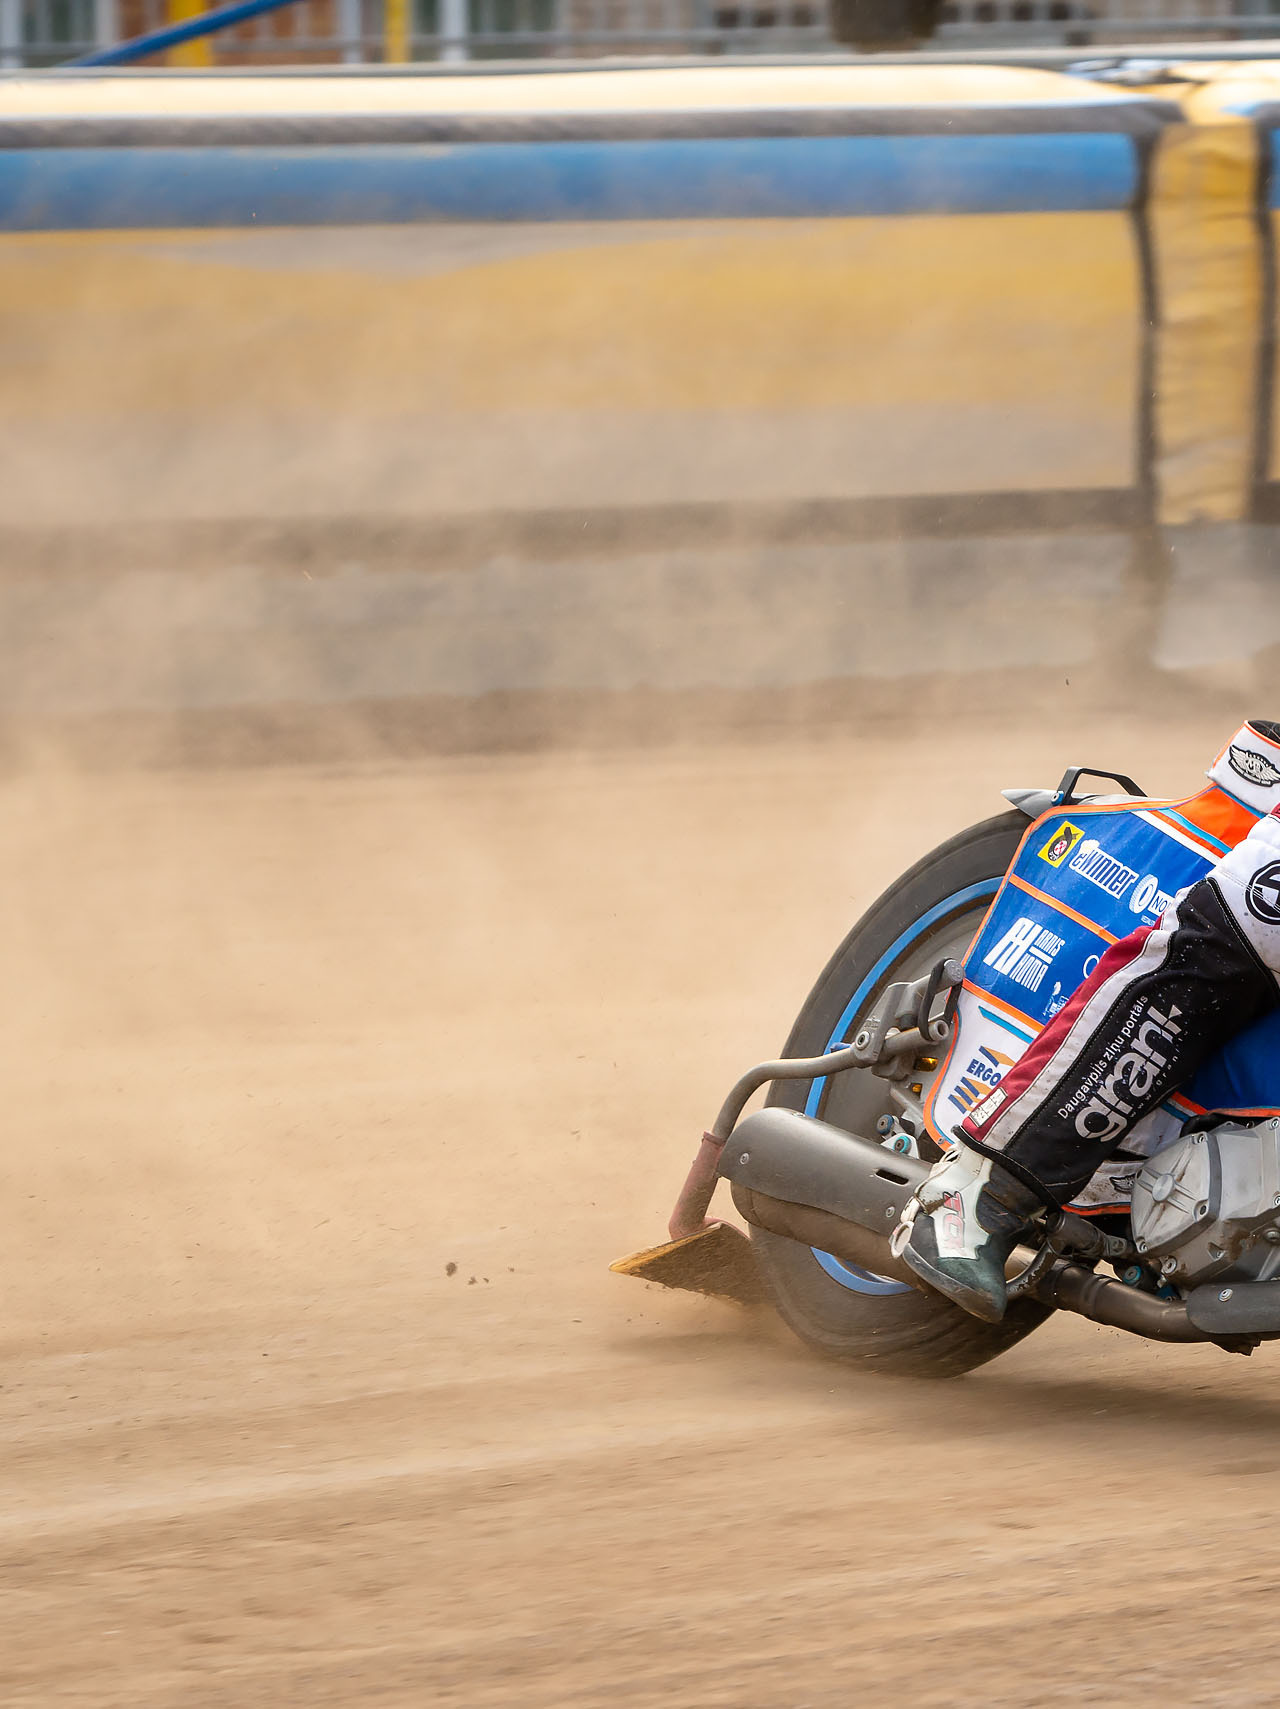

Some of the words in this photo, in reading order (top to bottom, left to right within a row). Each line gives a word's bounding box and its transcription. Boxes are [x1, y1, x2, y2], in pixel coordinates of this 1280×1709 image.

[966, 1058, 1002, 1086] ERGO
[1058, 1060, 1108, 1119] Daugavpils
[1103, 1039, 1125, 1061] ziņu
[1121, 995, 1149, 1040] portāls
